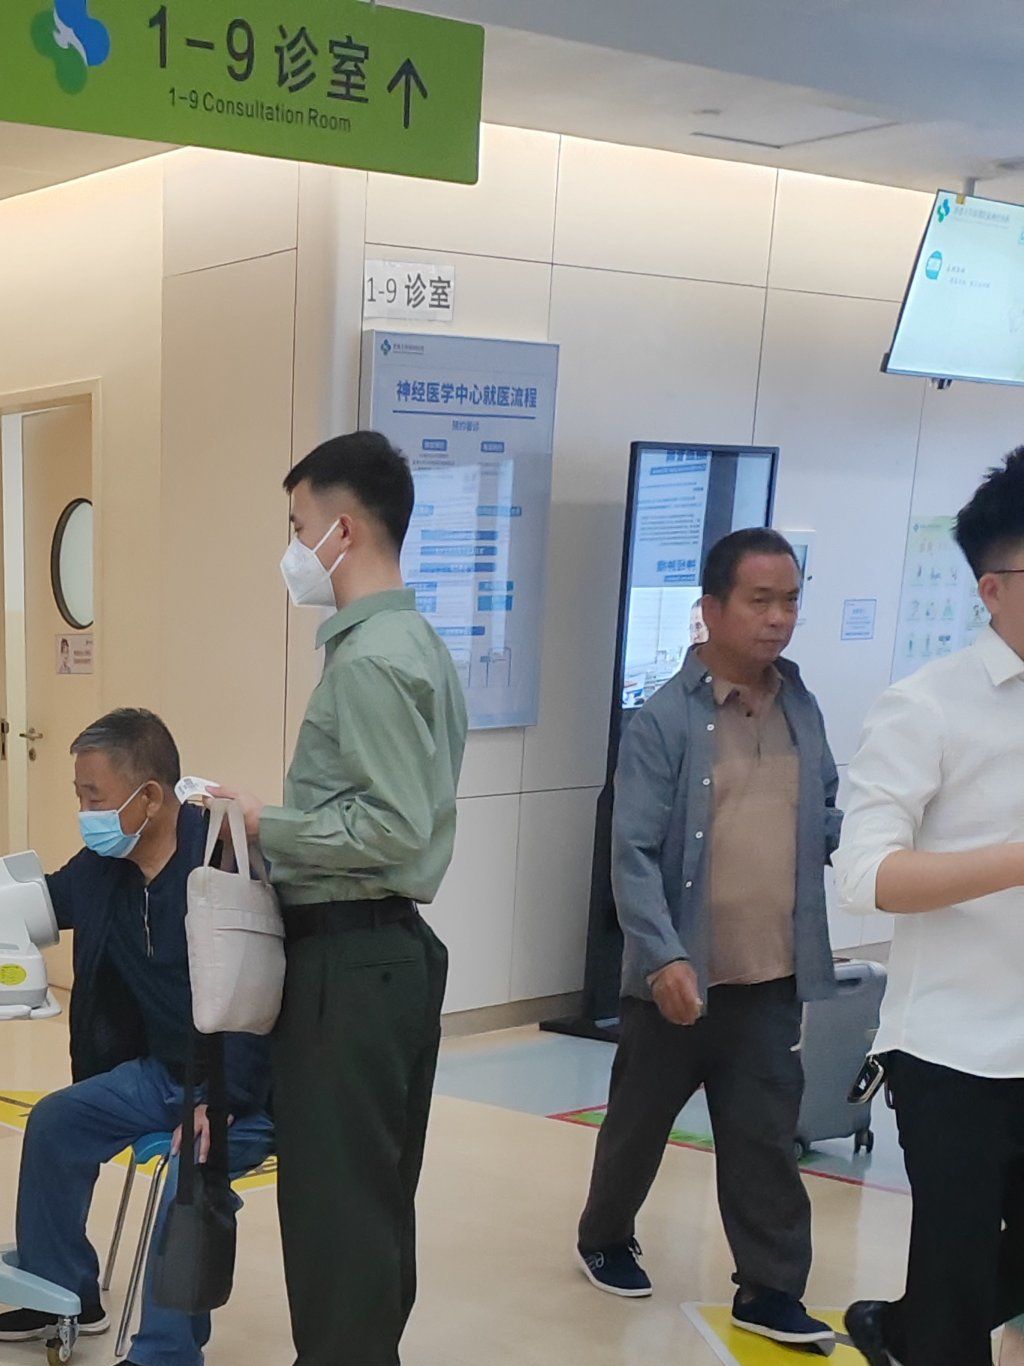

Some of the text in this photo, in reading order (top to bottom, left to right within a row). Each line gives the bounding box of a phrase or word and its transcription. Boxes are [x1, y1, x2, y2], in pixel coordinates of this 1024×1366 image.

[169, 86, 352, 134] 1-9 Consultation Room
[396, 379, 538, 409] 神经医学中心就医流程
